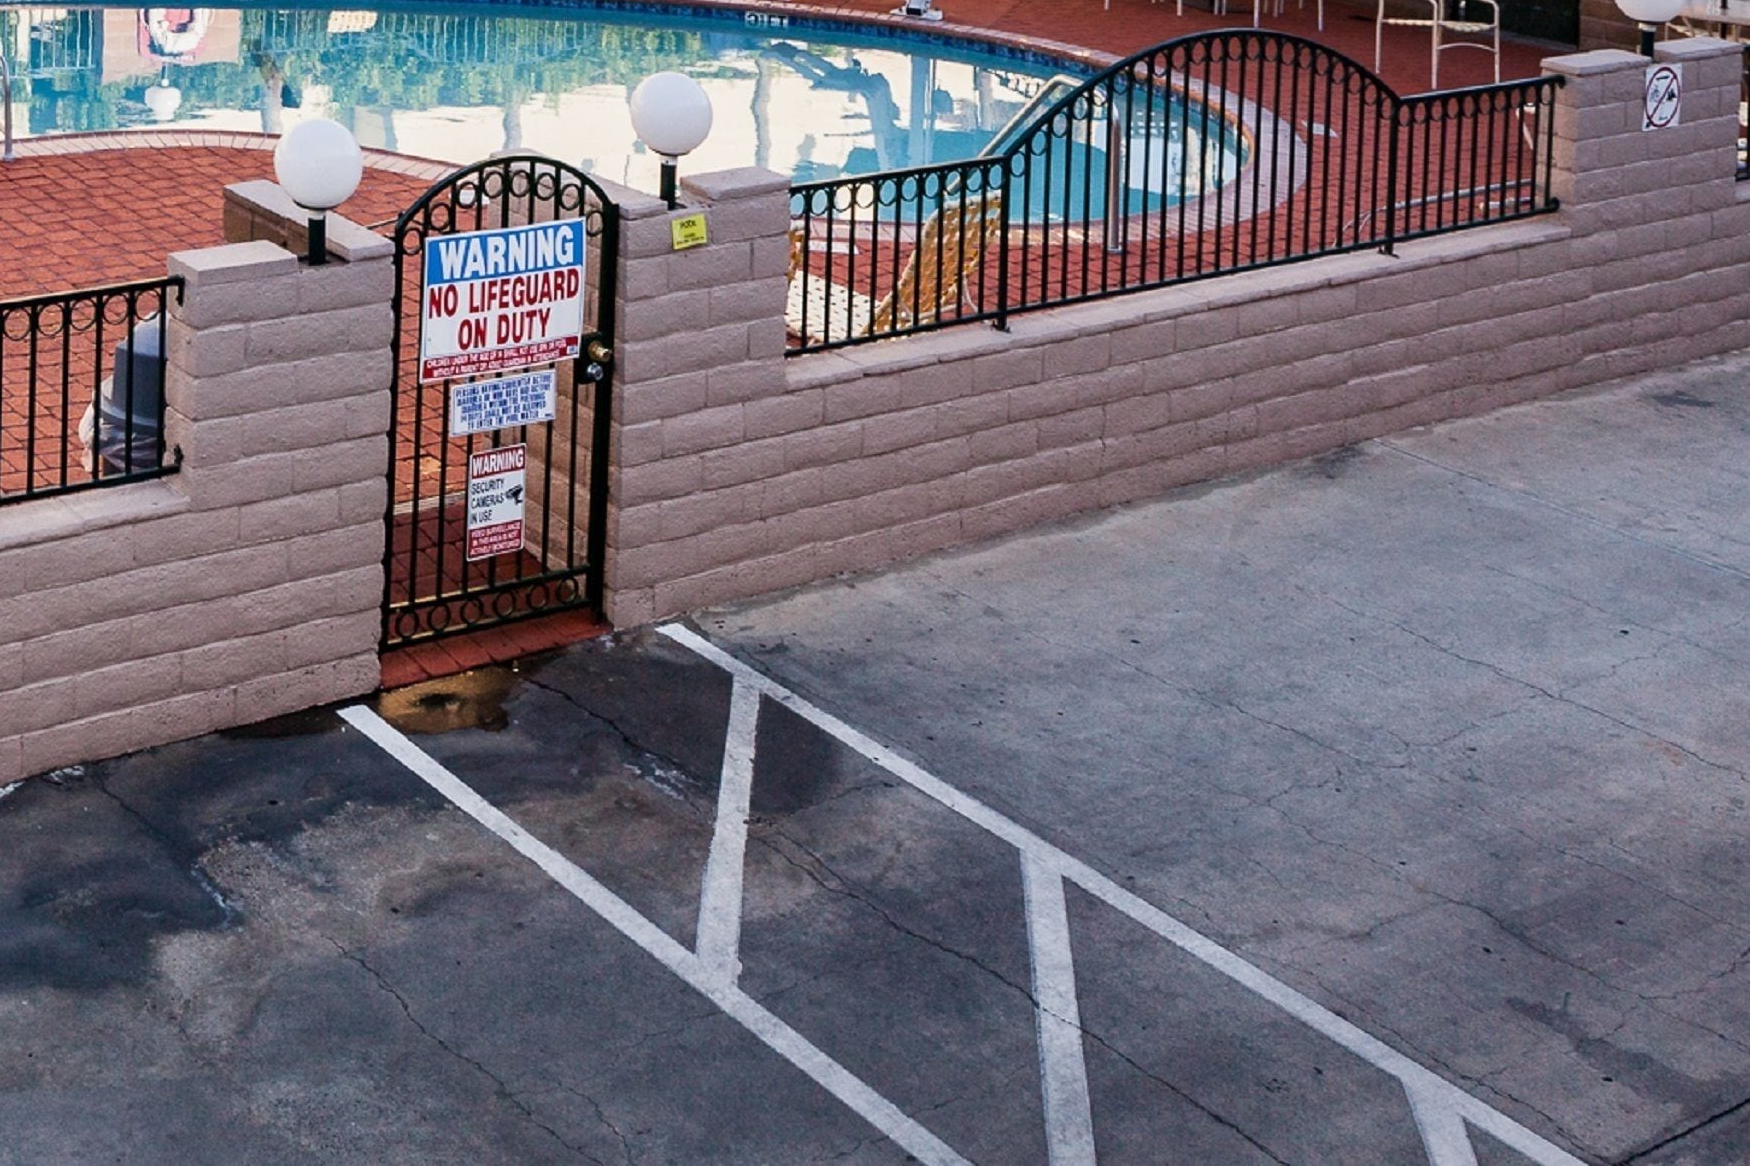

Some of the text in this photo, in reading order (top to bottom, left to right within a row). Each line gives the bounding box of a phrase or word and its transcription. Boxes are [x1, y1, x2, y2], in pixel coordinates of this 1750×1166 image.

[439, 225, 574, 280] WARNING
[429, 268, 580, 319] NO LIFEGUARD
[458, 307, 551, 350] ON DUTY
[472, 448, 524, 477] WARNING
[471, 479, 504, 495] SECURITY
[471, 493, 504, 509] CAMERAS
[471, 509, 492, 524] IN USE
